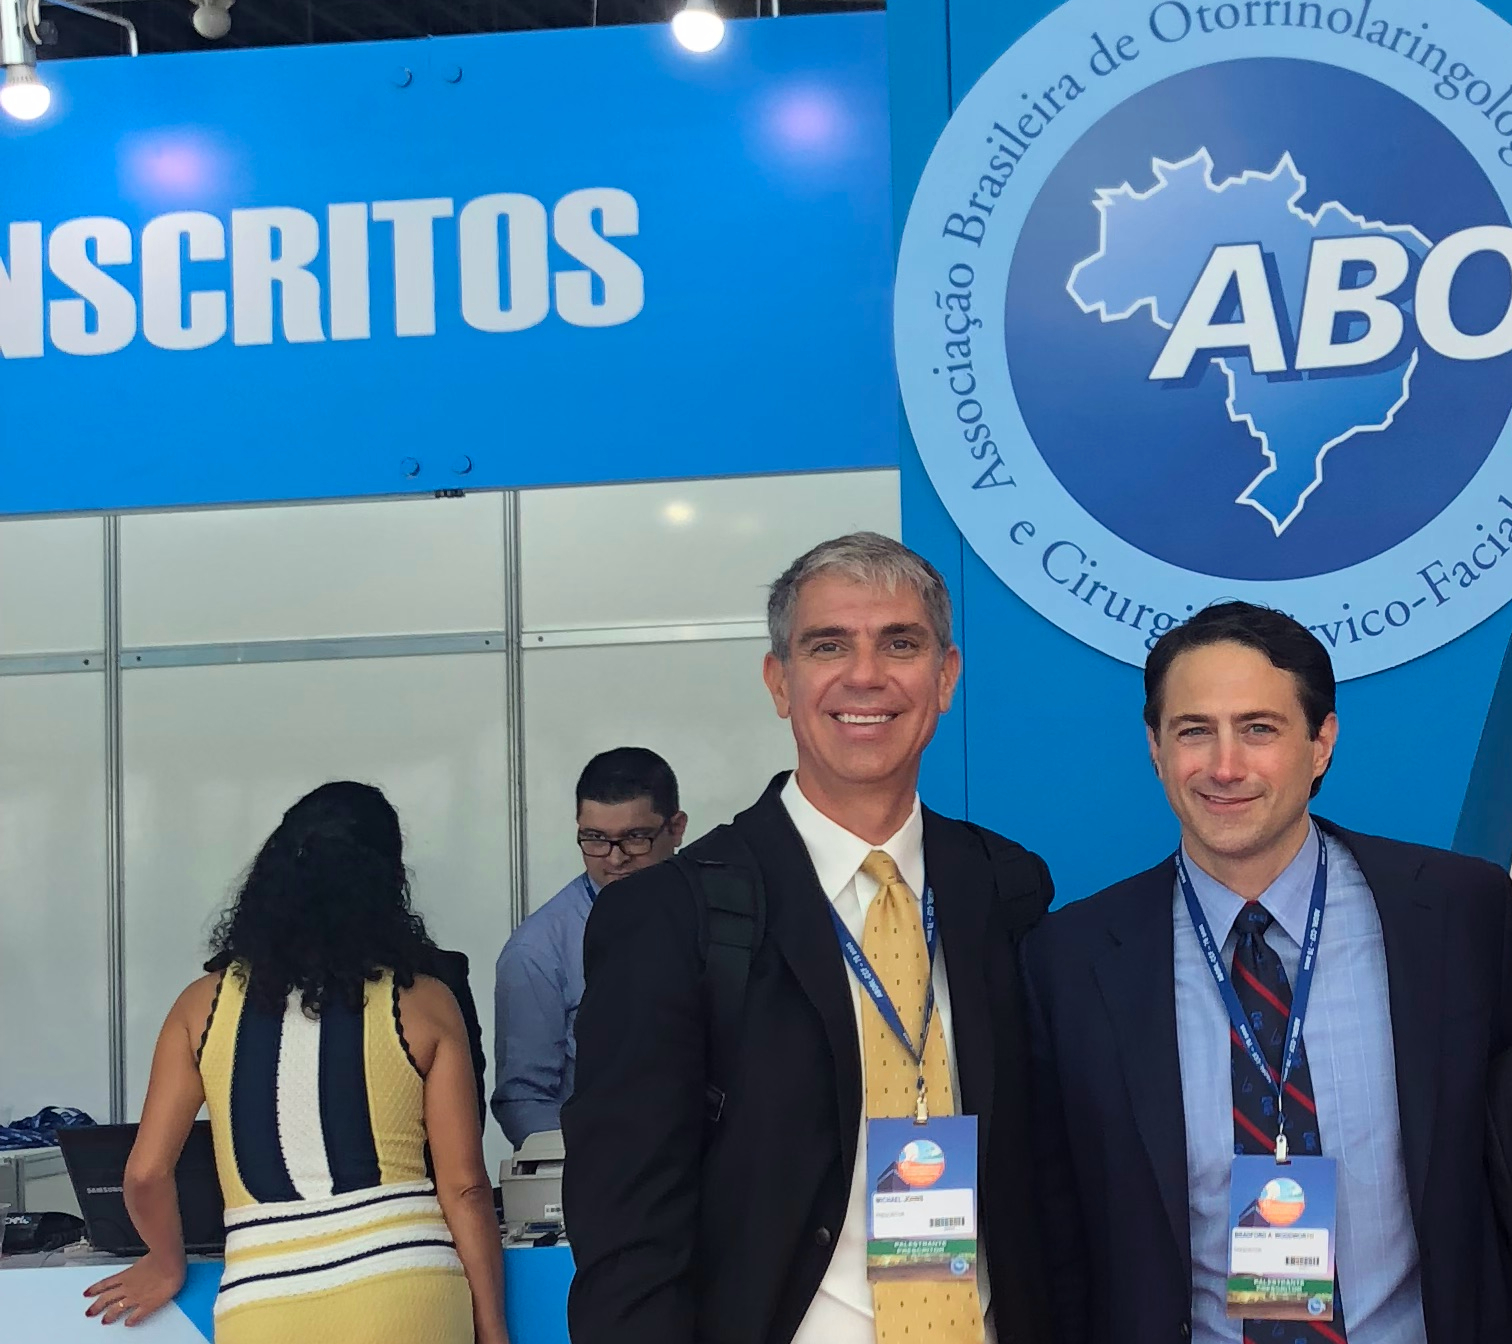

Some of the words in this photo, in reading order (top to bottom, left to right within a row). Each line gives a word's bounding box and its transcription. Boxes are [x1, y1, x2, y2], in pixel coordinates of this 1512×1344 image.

[1089, 31, 1141, 77] de
[942, 74, 1087, 248] Brasileira
[933, 263, 1017, 491] Associação
[1009, 519, 1037, 547] e
